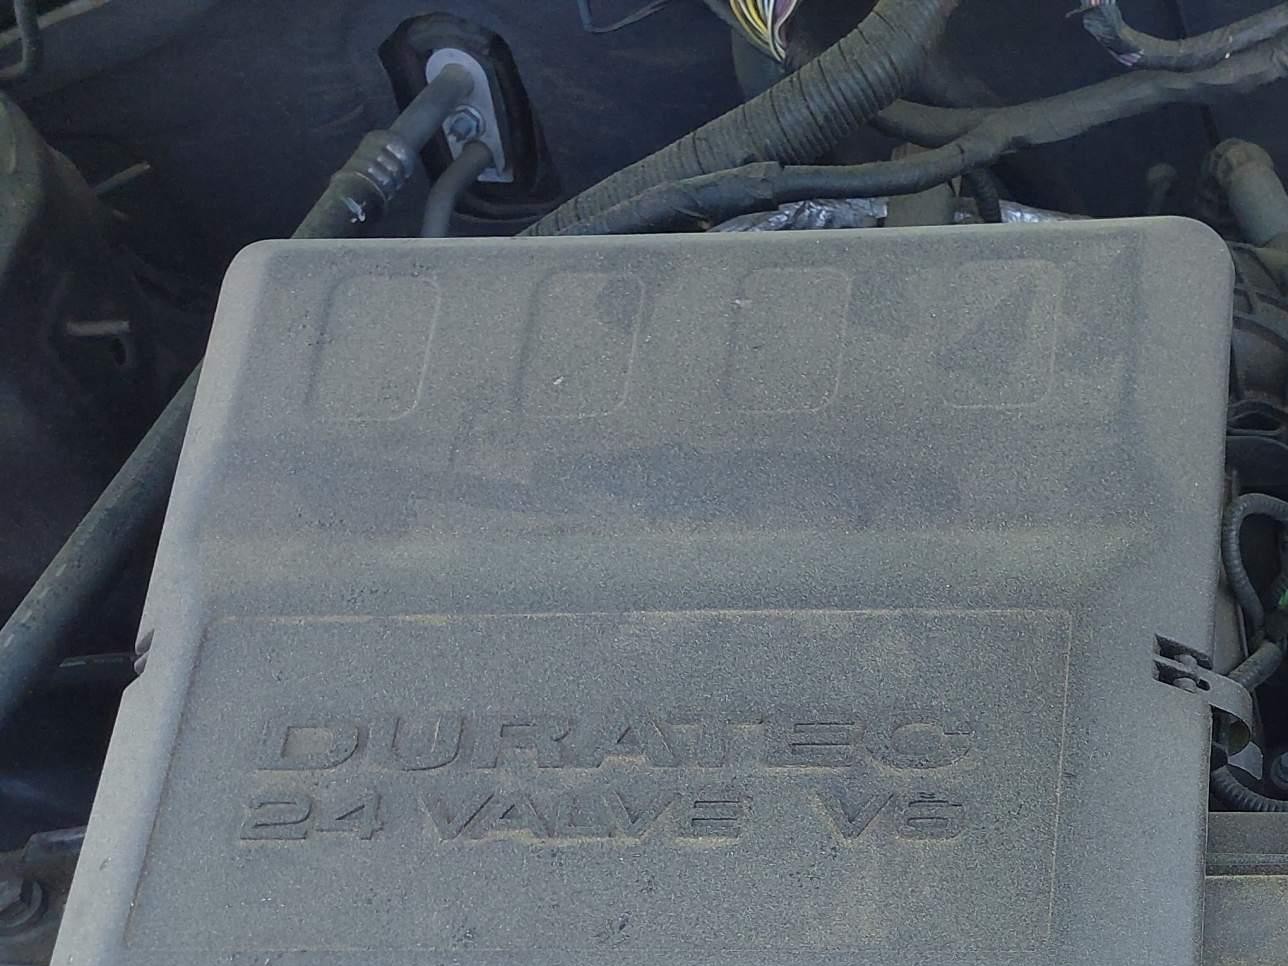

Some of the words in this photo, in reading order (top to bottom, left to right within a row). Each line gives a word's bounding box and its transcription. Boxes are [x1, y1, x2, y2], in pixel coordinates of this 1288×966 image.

[257, 712, 976, 771] DURATEC
[240, 788, 386, 841] 24
[424, 788, 754, 841] VALVE
[815, 786, 964, 841] V6
